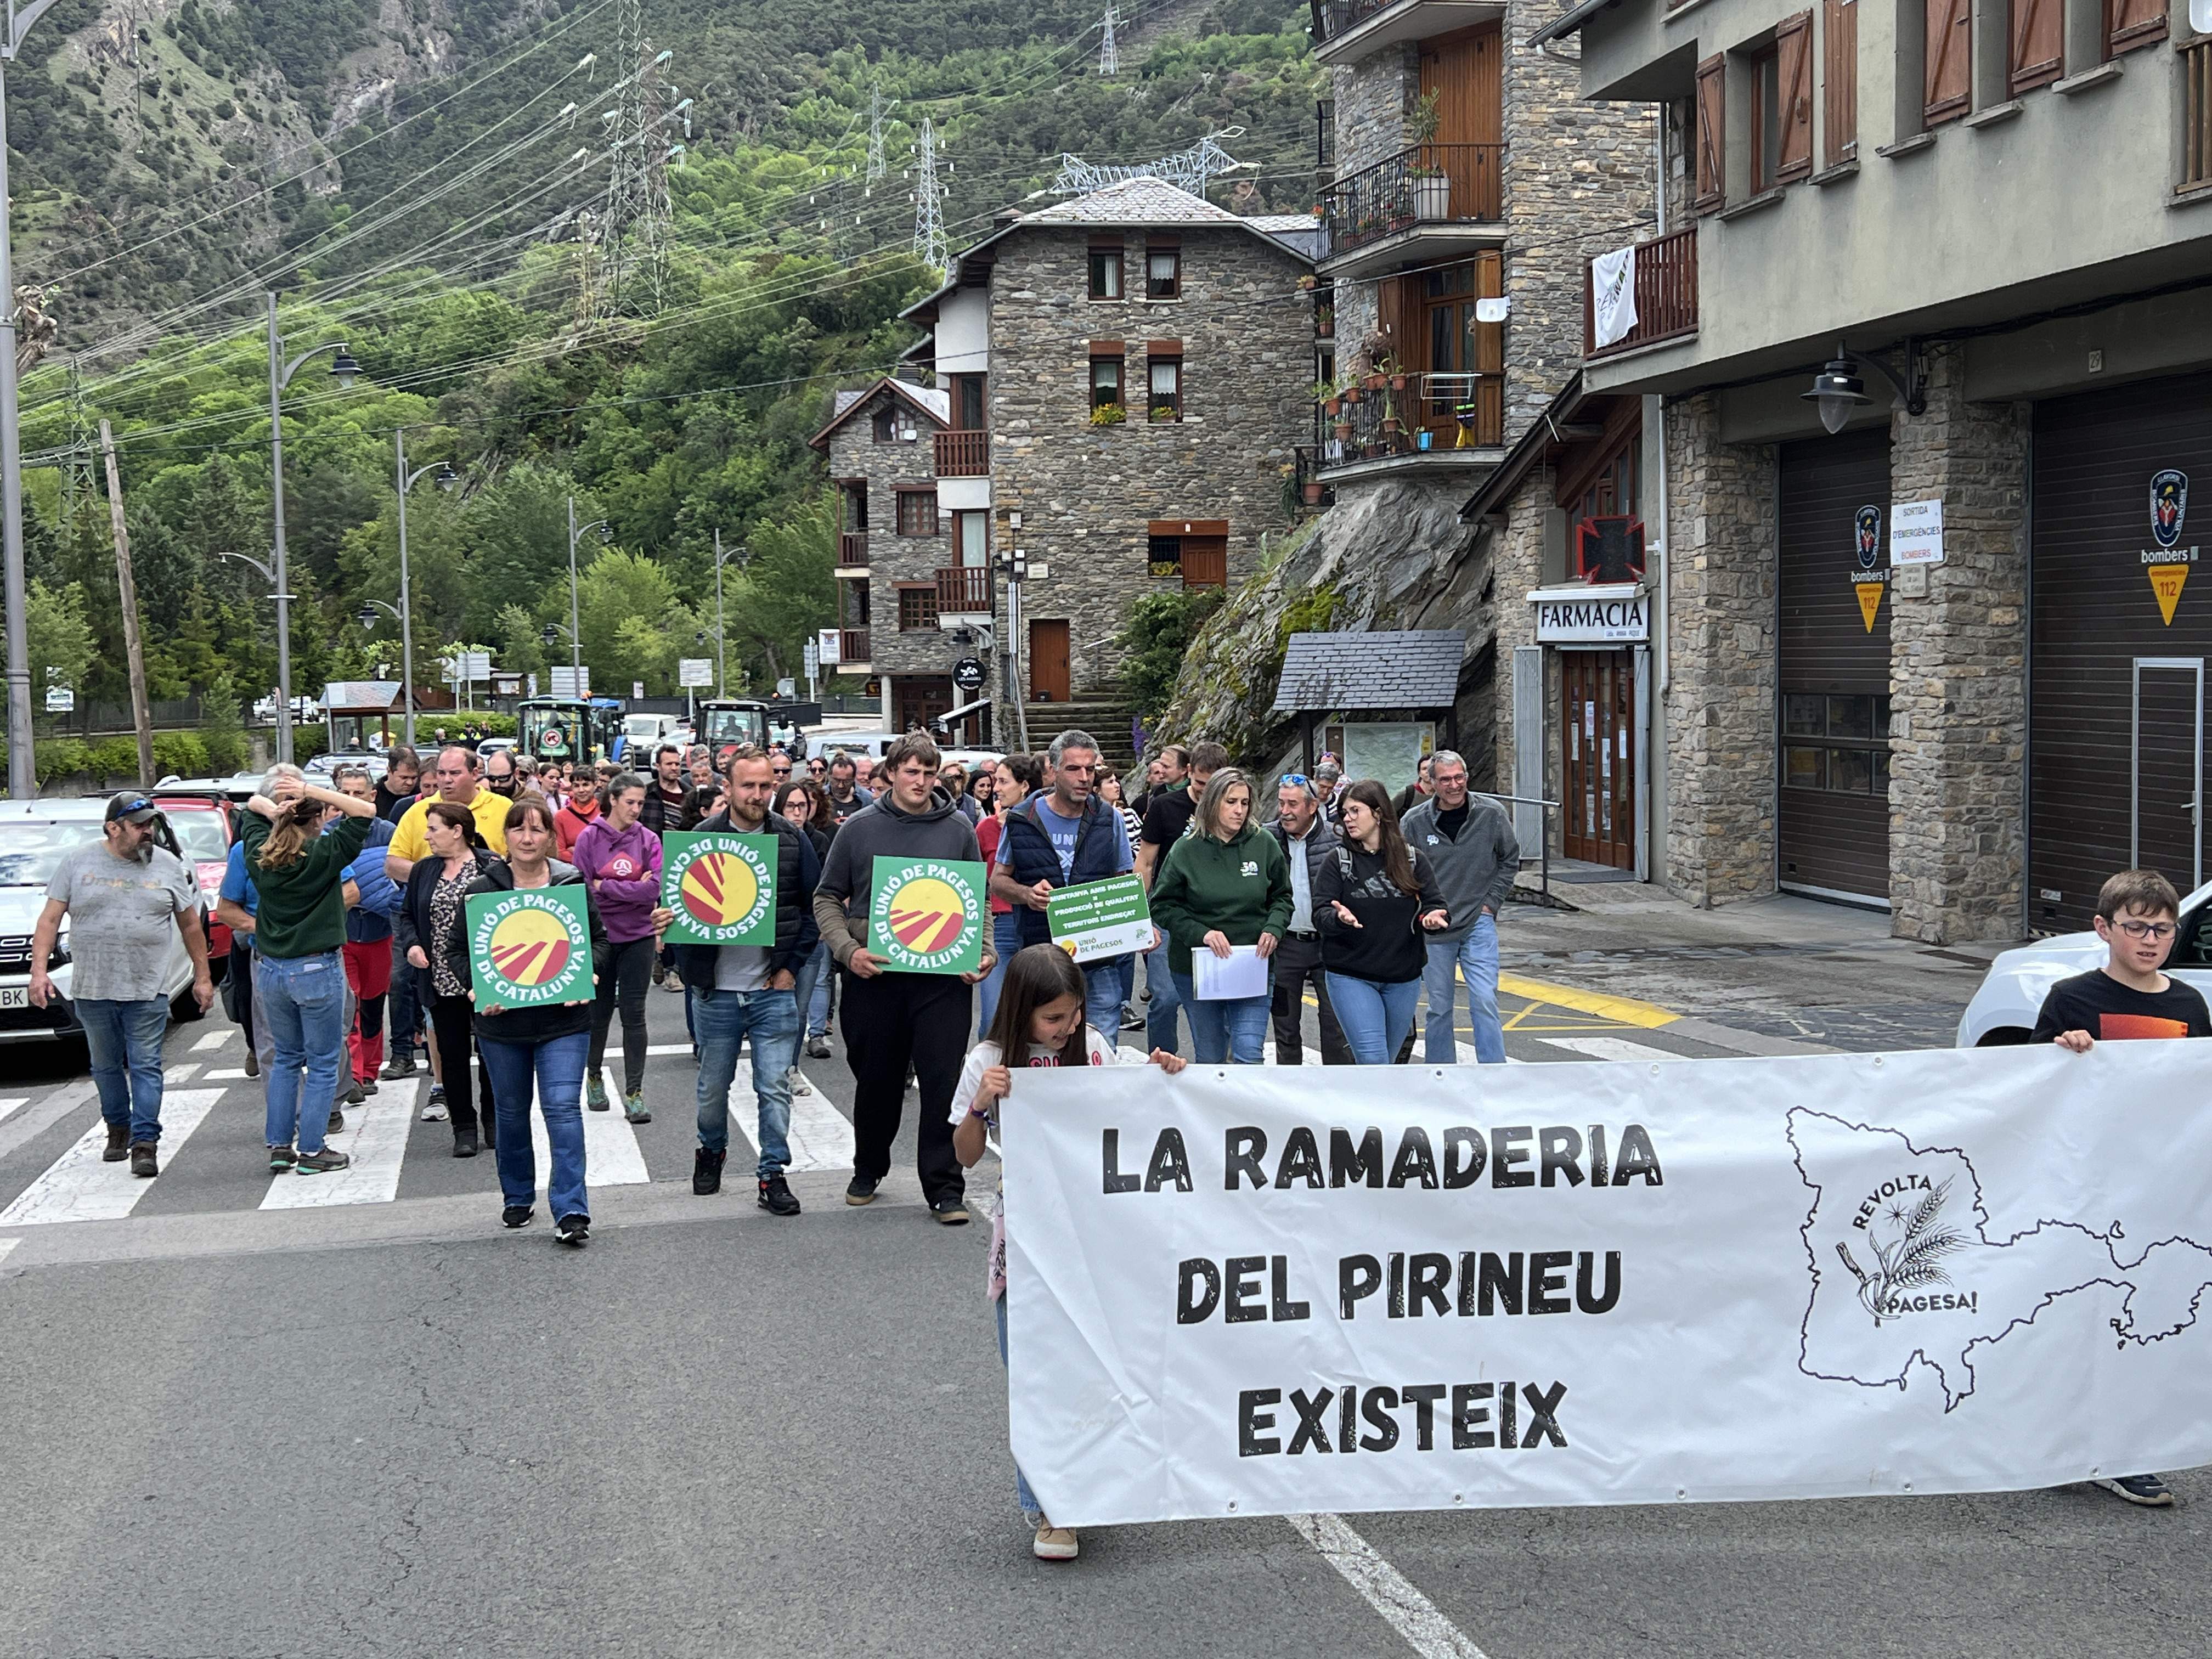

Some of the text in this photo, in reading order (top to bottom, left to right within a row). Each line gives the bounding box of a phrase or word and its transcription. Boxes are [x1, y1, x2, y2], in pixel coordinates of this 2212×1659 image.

[1903, 506, 1928, 517] SORTIDA
[1893, 526, 1941, 540] D'EMERGÈNCIES
[1901, 549, 1932, 560] BOMBERS
[2141, 548, 2188, 563] bombers
[1851, 570, 1883, 583] bombers
[2159, 581, 2177, 596] 112
[1541, 599, 1643, 628] FARMÀCIA
[1864, 596, 1876, 610] 112
[666, 838, 772, 940] UNIÓ DE PAGESOS DE CATALUNYA
[874, 864, 979, 921] UNIÓ DE PAGESOS
[1090, 885, 1107, 895] AMB
[1107, 879, 1139, 891] PAGESOS
[1054, 902, 1093, 916] PRODUCCIÓ
[1104, 894, 1139, 907] QUALITAT
[474, 894, 585, 955] UNIÓ DE PAGESOS
[1063, 909, 1136, 929] TERRITORI ENDREÇAT
[874, 921, 978, 969] DE CATALUNYA
[1078, 936, 1097, 946] UNIÓ
[1091, 939, 1123, 951] PAGESOS
[476, 950, 586, 1002] DE CATALUNYA
[1103, 1125, 1663, 1194] LA RAMADERIA
[1853, 1174, 1933, 1230] REVOLTA
[1177, 1251, 1621, 1324] DEL PIRINEU
[1887, 1290, 1978, 1314] PAGESA!
[1239, 1381, 1567, 1457] EXISTEIX
